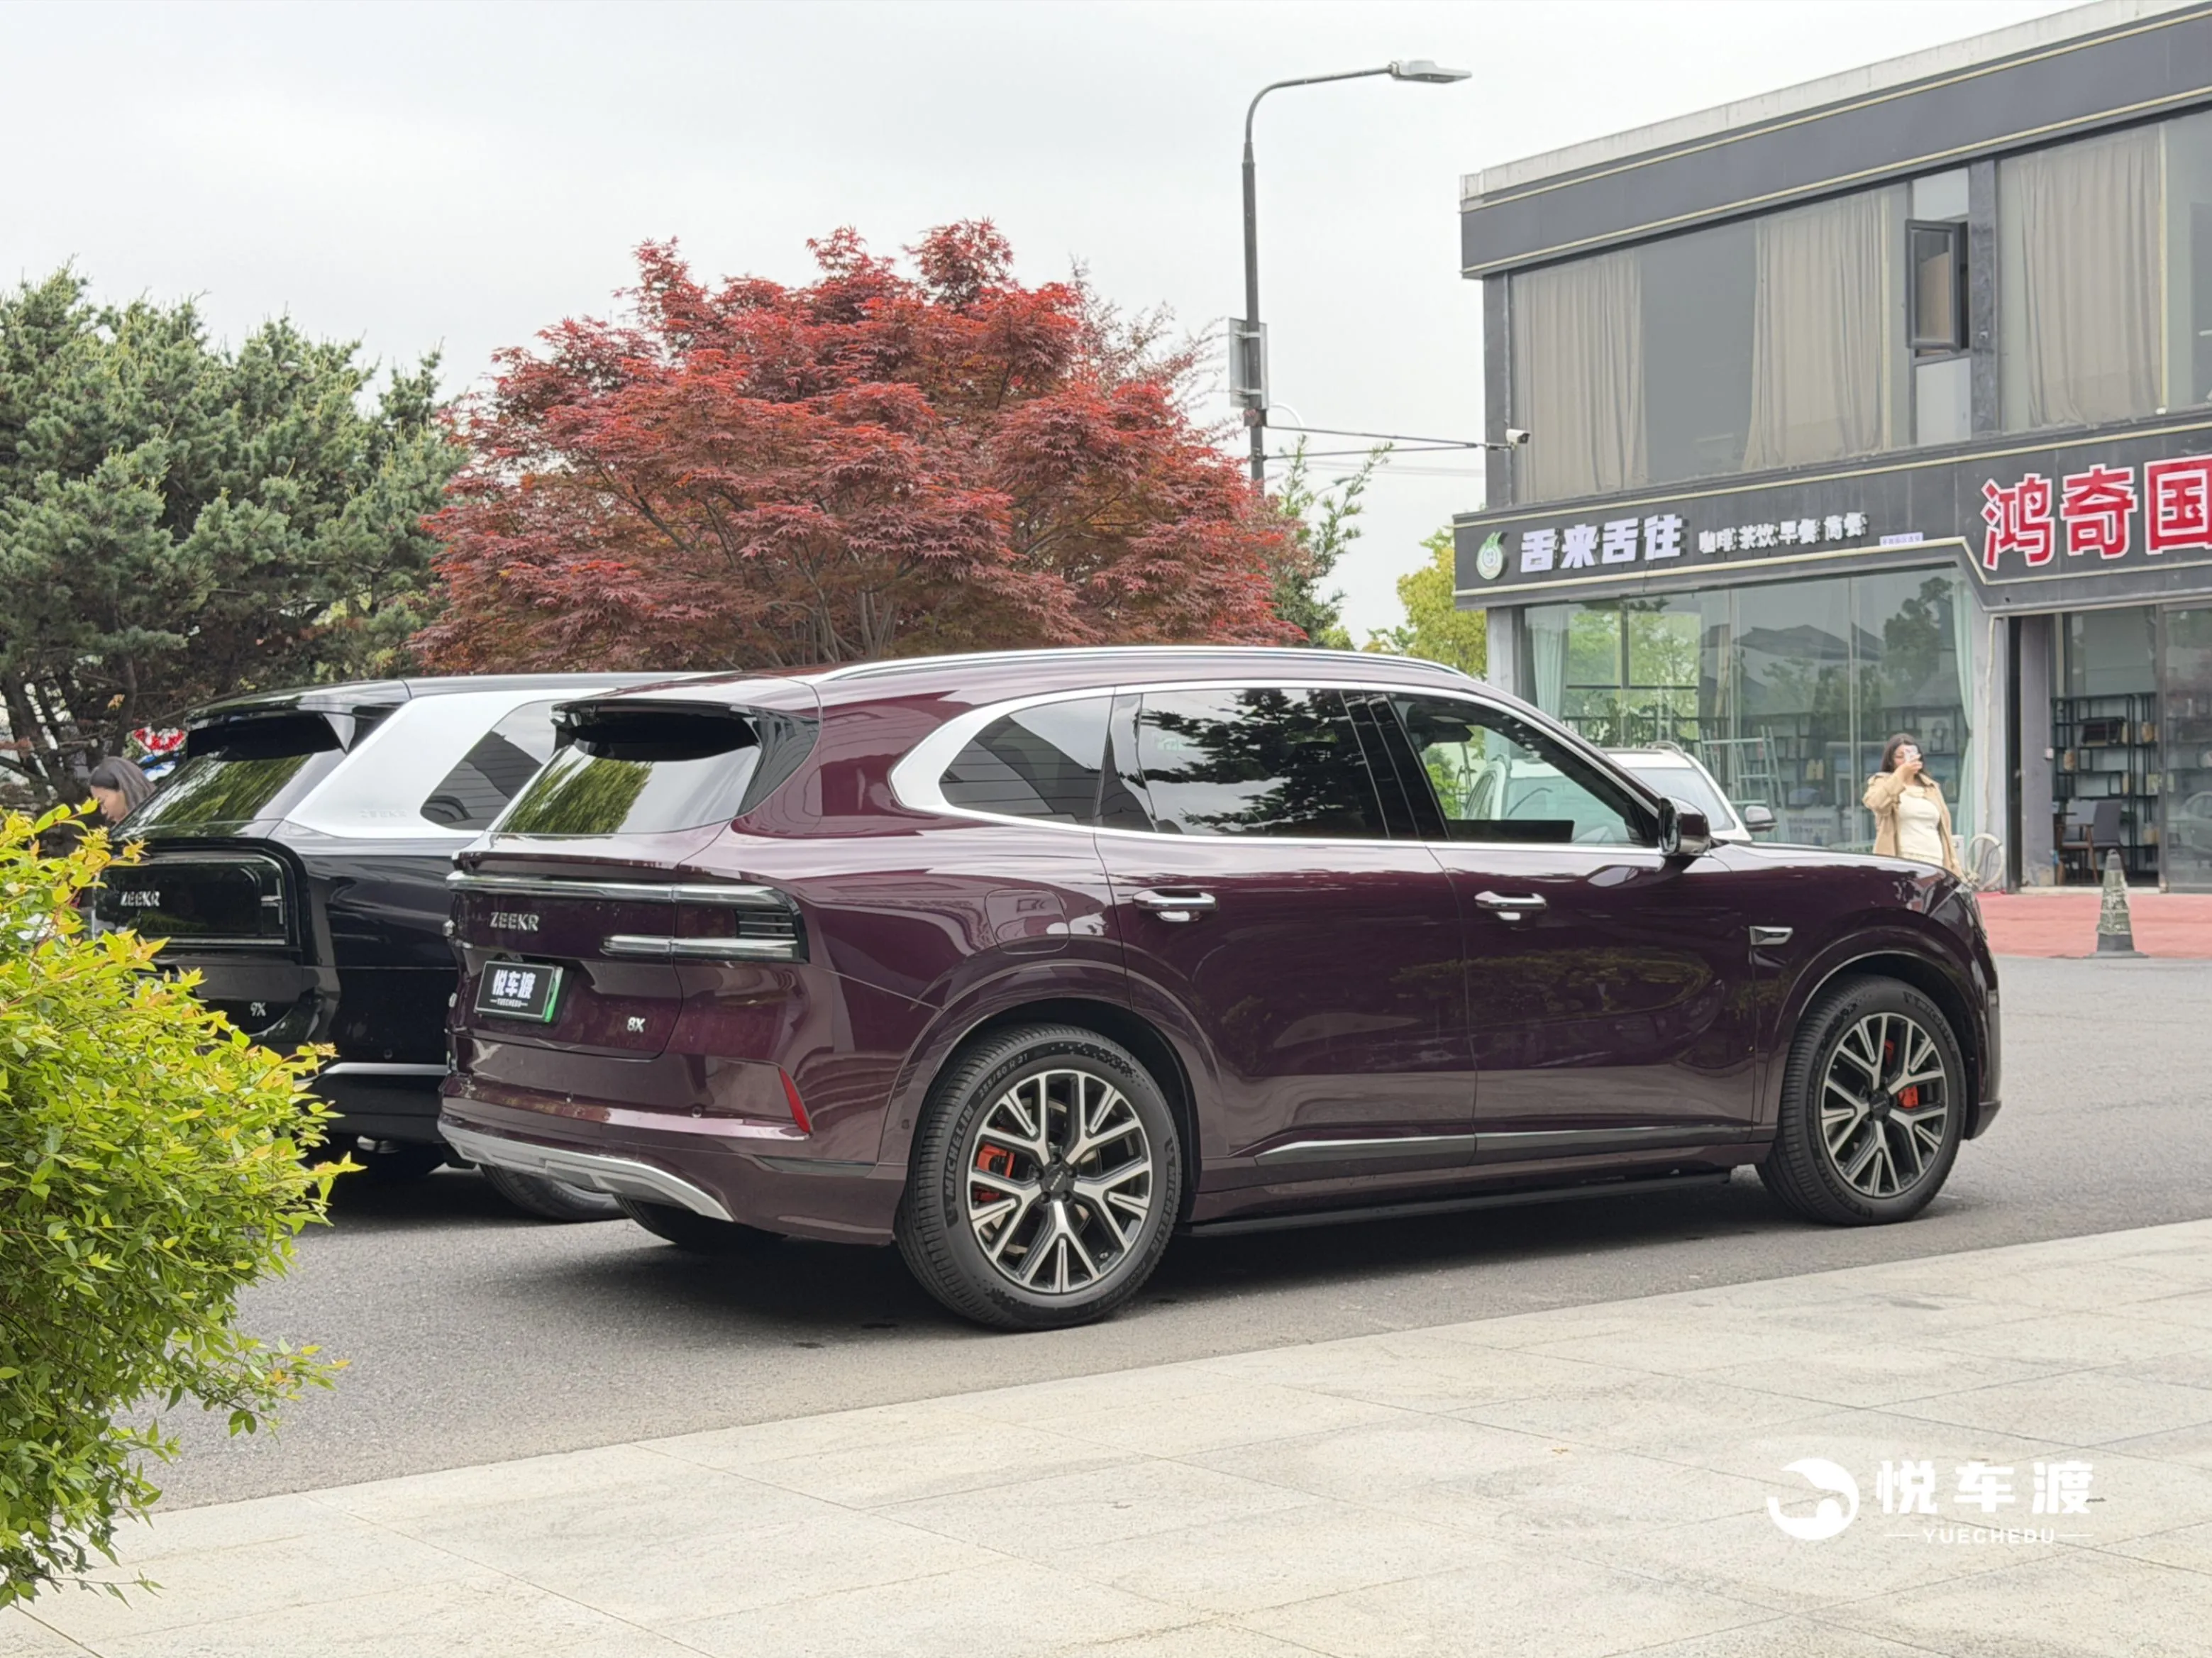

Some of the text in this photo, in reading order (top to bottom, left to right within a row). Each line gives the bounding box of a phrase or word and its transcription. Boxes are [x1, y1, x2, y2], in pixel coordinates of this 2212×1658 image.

[1981, 454, 2212, 571] 鸿奇国
[1520, 514, 1683, 573] 舌来舌往
[1740, 522, 1779, 550] 茶饮
[120, 890, 161, 907] ZEEKR
[490, 911, 540, 932] ZEEKR
[492, 969, 536, 999] 悦车渡
[250, 1002, 267, 1017] 9X
[627, 1017, 646, 1033] 8X
[944, 1104, 975, 1197] MICHELIN
